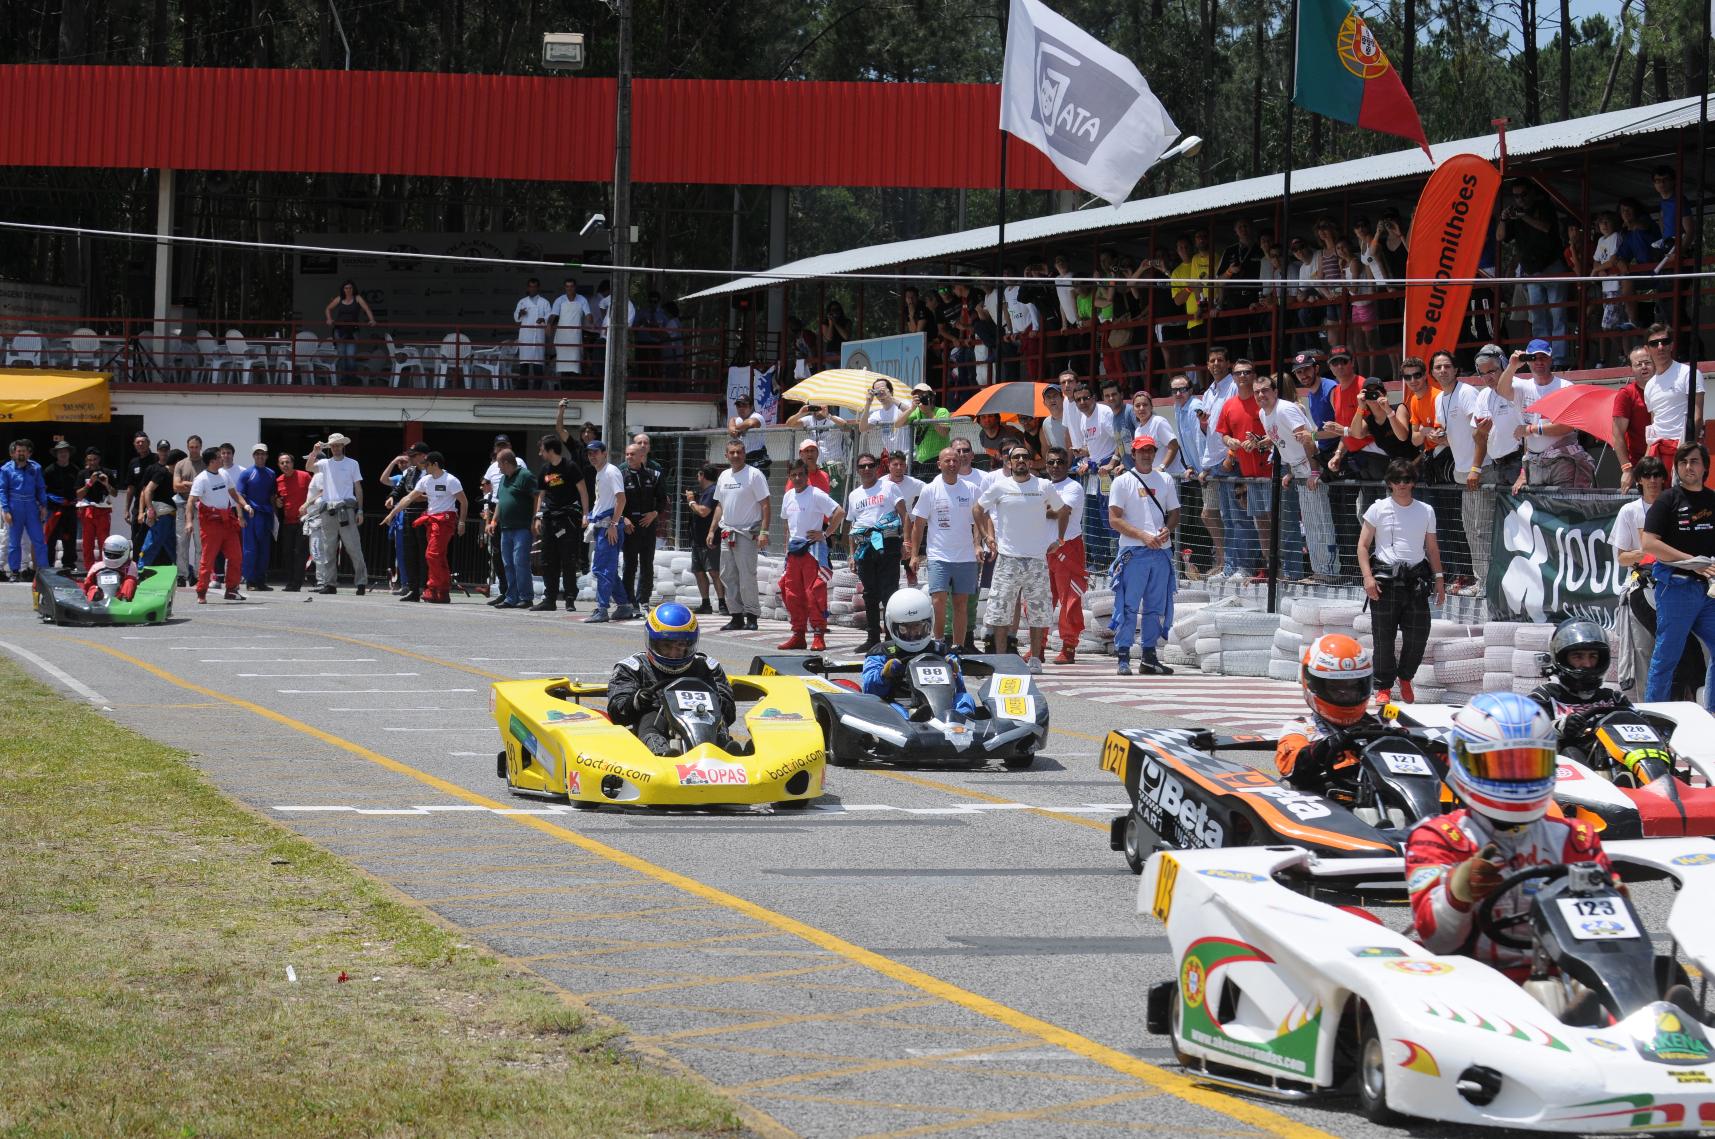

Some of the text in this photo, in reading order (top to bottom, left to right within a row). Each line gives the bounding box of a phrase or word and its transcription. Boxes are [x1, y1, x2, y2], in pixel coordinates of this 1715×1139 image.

[1425, 173, 1478, 324] euromilhões
[855, 494, 885, 510] UNITRIP
[922, 667, 943, 676] 88
[680, 691, 707, 701] 93
[1621, 724, 1646, 733] 128
[1105, 739, 1126, 776] 127
[1391, 754, 1417, 764] 127
[1158, 773, 1224, 849] Beta
[1573, 900, 1617, 917] 123
